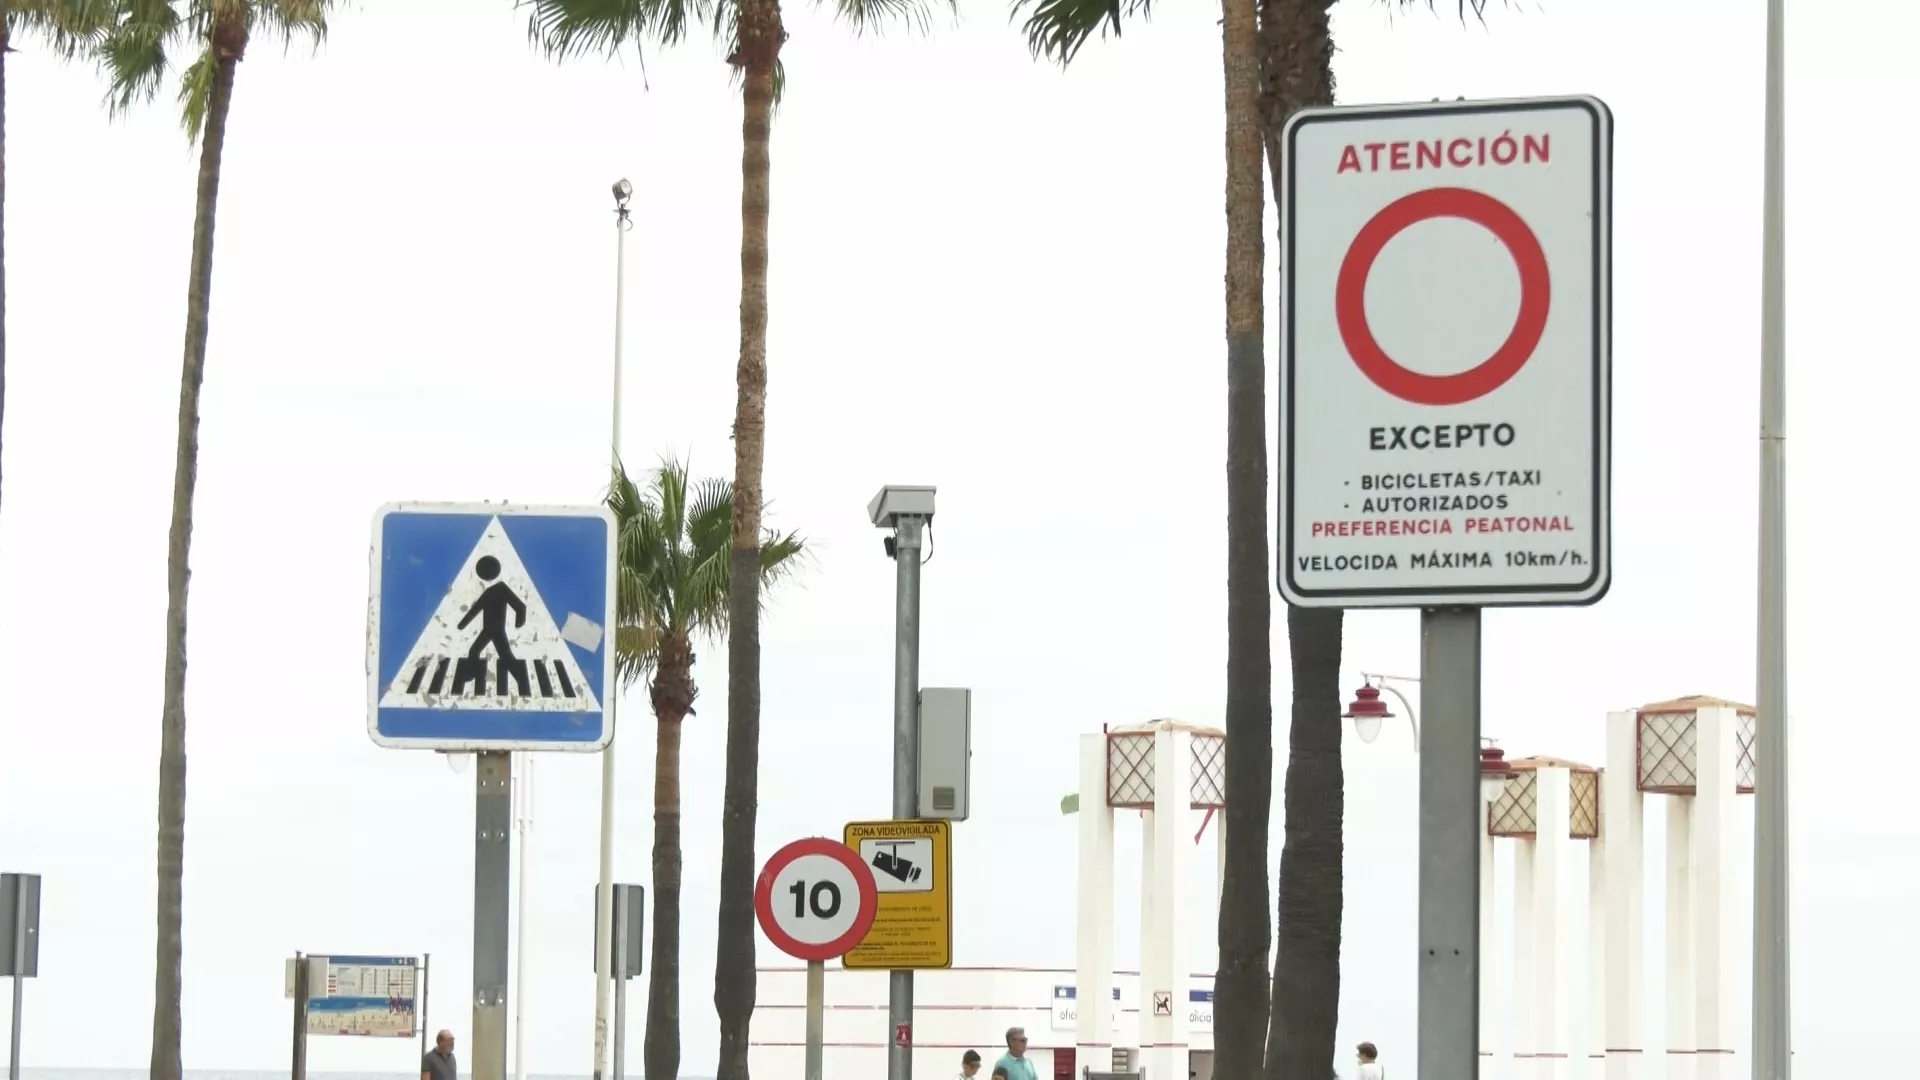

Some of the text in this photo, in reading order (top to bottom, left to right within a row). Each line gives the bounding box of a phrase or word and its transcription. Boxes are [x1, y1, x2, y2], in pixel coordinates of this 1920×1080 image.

[1336, 130, 1551, 174] ATENCIÓN
[1369, 423, 1517, 451] EXCEPTO
[1361, 470, 1542, 491] BICICLETAS/TAXI
[1362, 494, 1509, 514] AUTORIZADOS
[1311, 515, 1576, 538] PREFERENCIA PEATONAL
[1298, 549, 1589, 572] VELOCIDA MÁXIMA 10km/h.
[852, 825, 940, 837] ZONA VIDEOVIGILADA
[789, 880, 842, 920] 10
